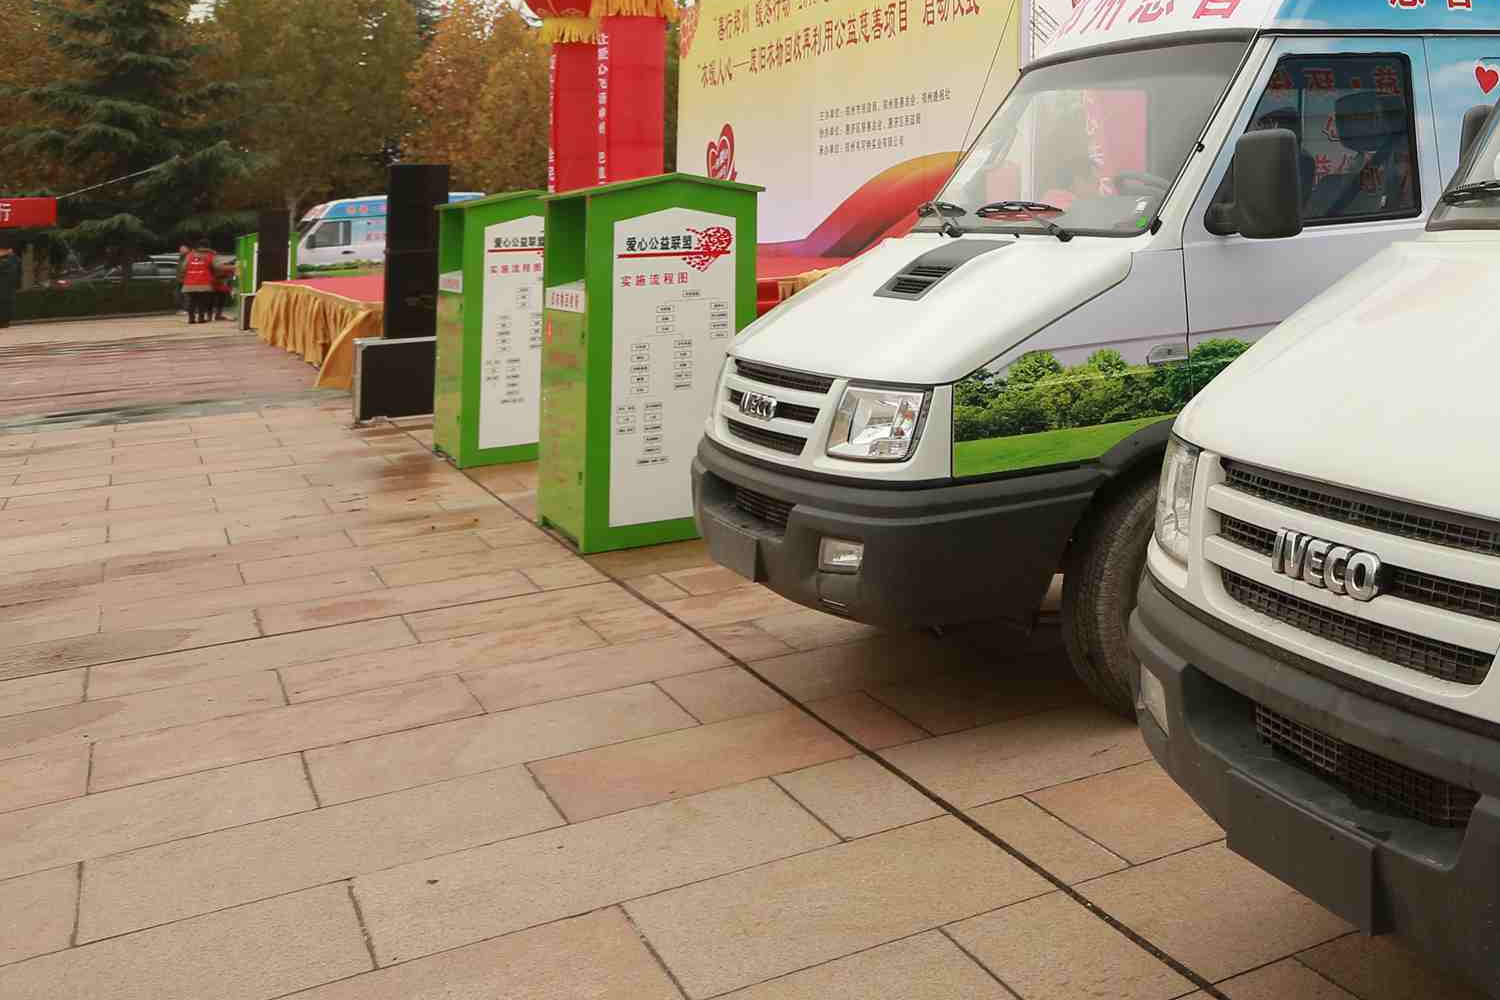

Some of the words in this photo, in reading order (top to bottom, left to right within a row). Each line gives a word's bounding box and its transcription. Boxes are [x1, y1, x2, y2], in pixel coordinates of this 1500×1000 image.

[625, 235, 693, 252] 爱心公益联盟
[1272, 527, 1379, 602] IVECO
